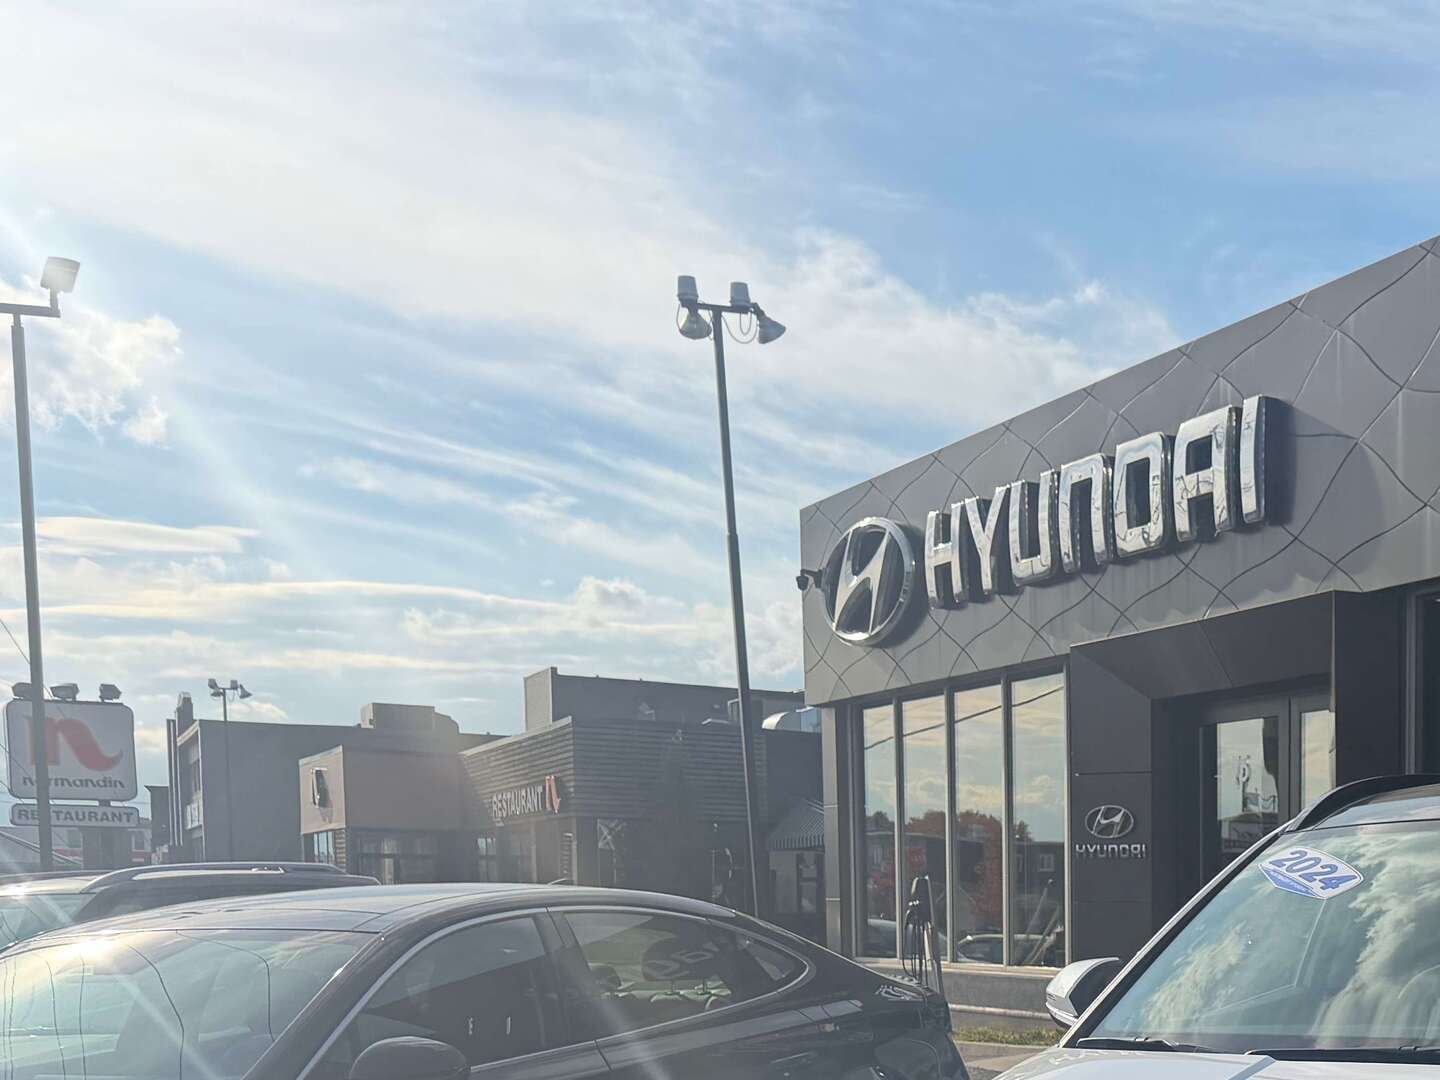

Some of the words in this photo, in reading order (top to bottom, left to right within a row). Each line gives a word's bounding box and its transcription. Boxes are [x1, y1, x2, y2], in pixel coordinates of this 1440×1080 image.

[923, 394, 1267, 608] HYUNDAI
[23, 776, 125, 789] nrmandin
[17, 809, 134, 823] RETAURANT
[491, 785, 543, 818] RESTAURANT
[1269, 850, 1358, 890] 2024
